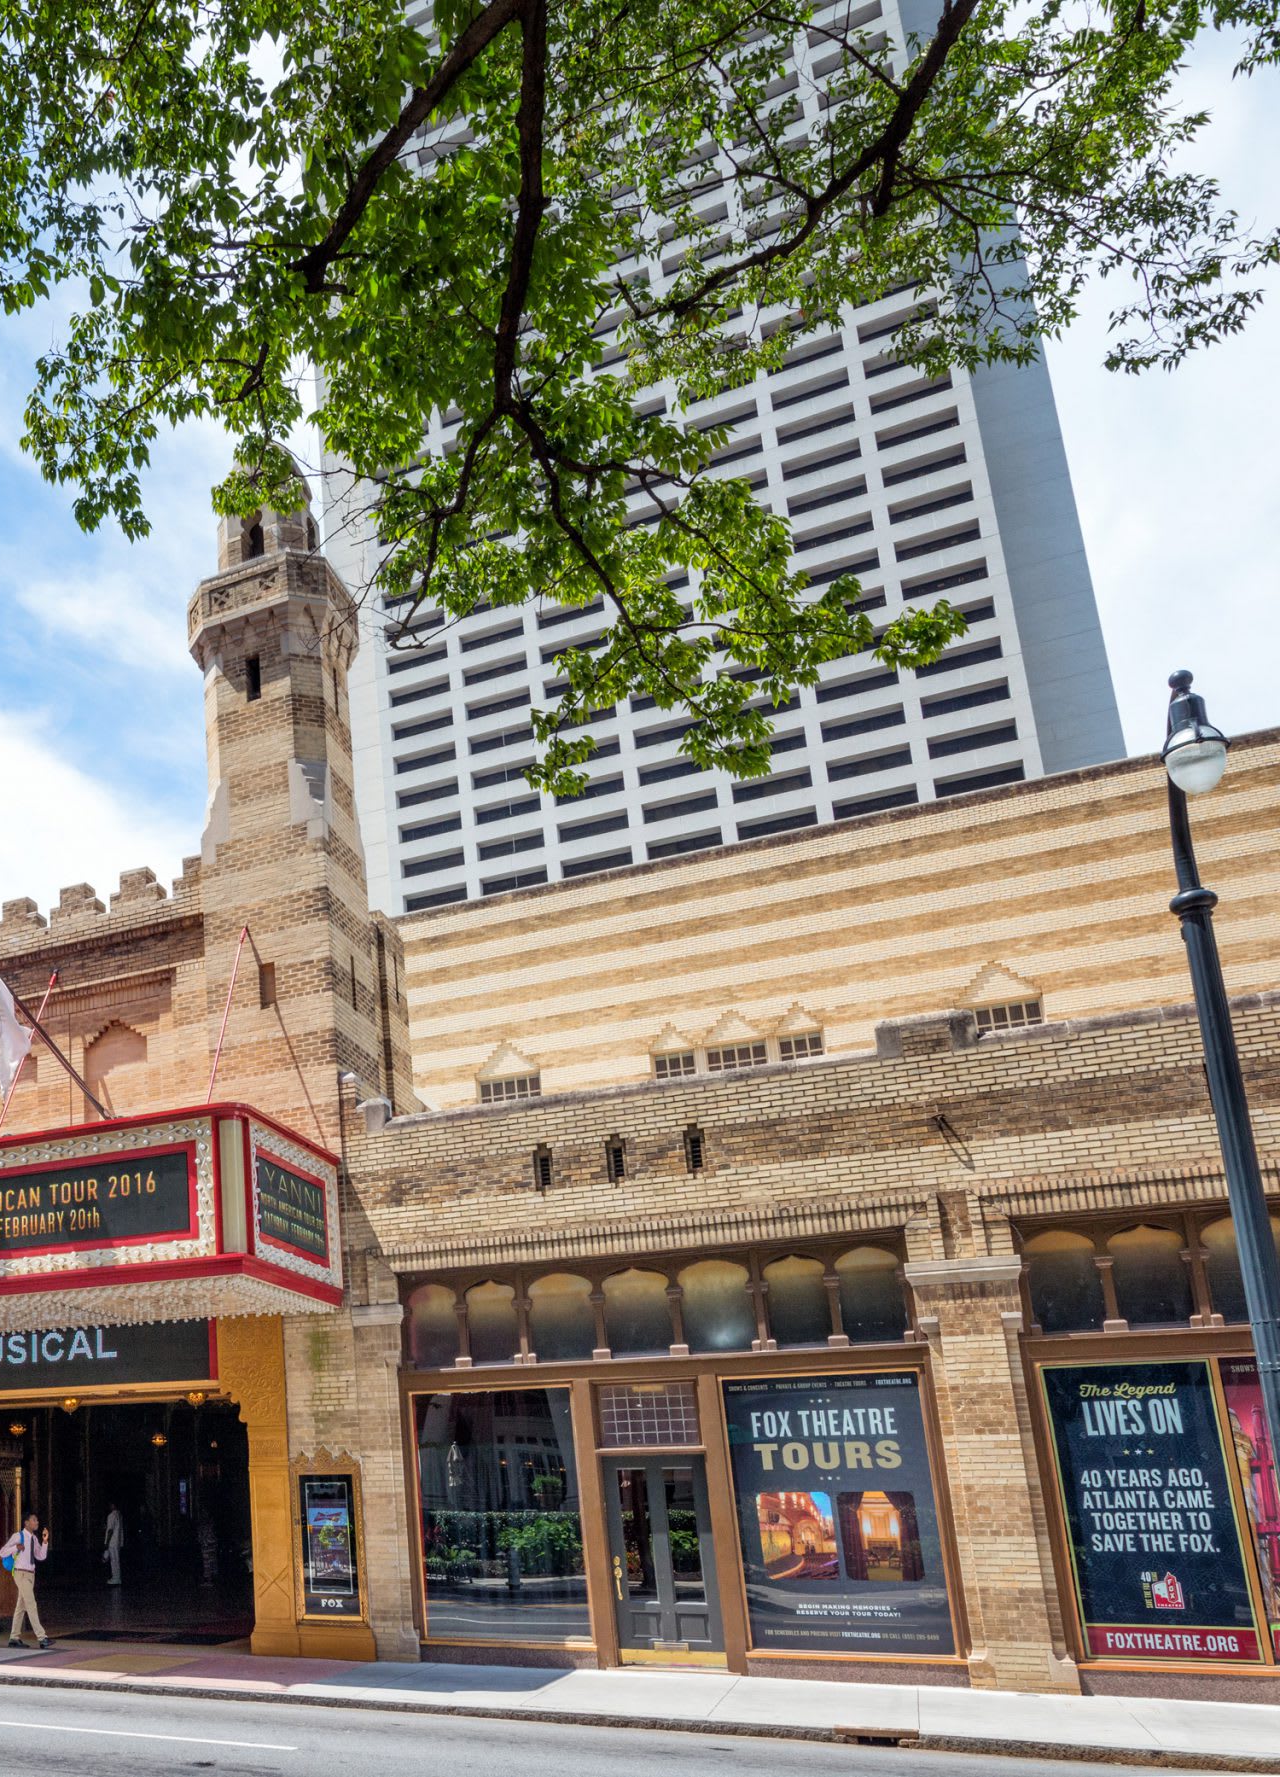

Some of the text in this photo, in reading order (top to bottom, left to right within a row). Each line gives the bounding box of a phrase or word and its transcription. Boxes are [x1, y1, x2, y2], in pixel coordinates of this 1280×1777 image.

[49, 1178, 98, 1205] TOUR
[108, 1170, 157, 1199] 2016
[264, 1166, 321, 1214] YANNI
[69, 1206, 101, 1231] 20th
[1230, 1364, 1255, 1373] SHOWS
[875, 1378, 912, 1386] FOXTHEATRE.ORG
[1079, 1382, 1177, 1399] The Legend
[750, 1407, 898, 1438] FOX THEATRE
[1081, 1398, 1184, 1436] LIVES ON
[753, 1440, 903, 1471] TOURS
[1080, 1468, 1209, 1489] 40 YEARS AGO,
[1083, 1490, 1215, 1509] ATLANTA CAME
[1090, 1511, 1212, 1531] TOGETHER TO
[1091, 1533, 1221, 1553] SAVE THE FOX.
[1140, 1571, 1151, 1582] 40
[1167, 1578, 1176, 1599] FOX
[320, 1598, 344, 1608] FOX
[841, 1631, 881, 1639] FOXTHEATRE.ORG
[1105, 1632, 1240, 1653] FOXTHEATRE.ORG
